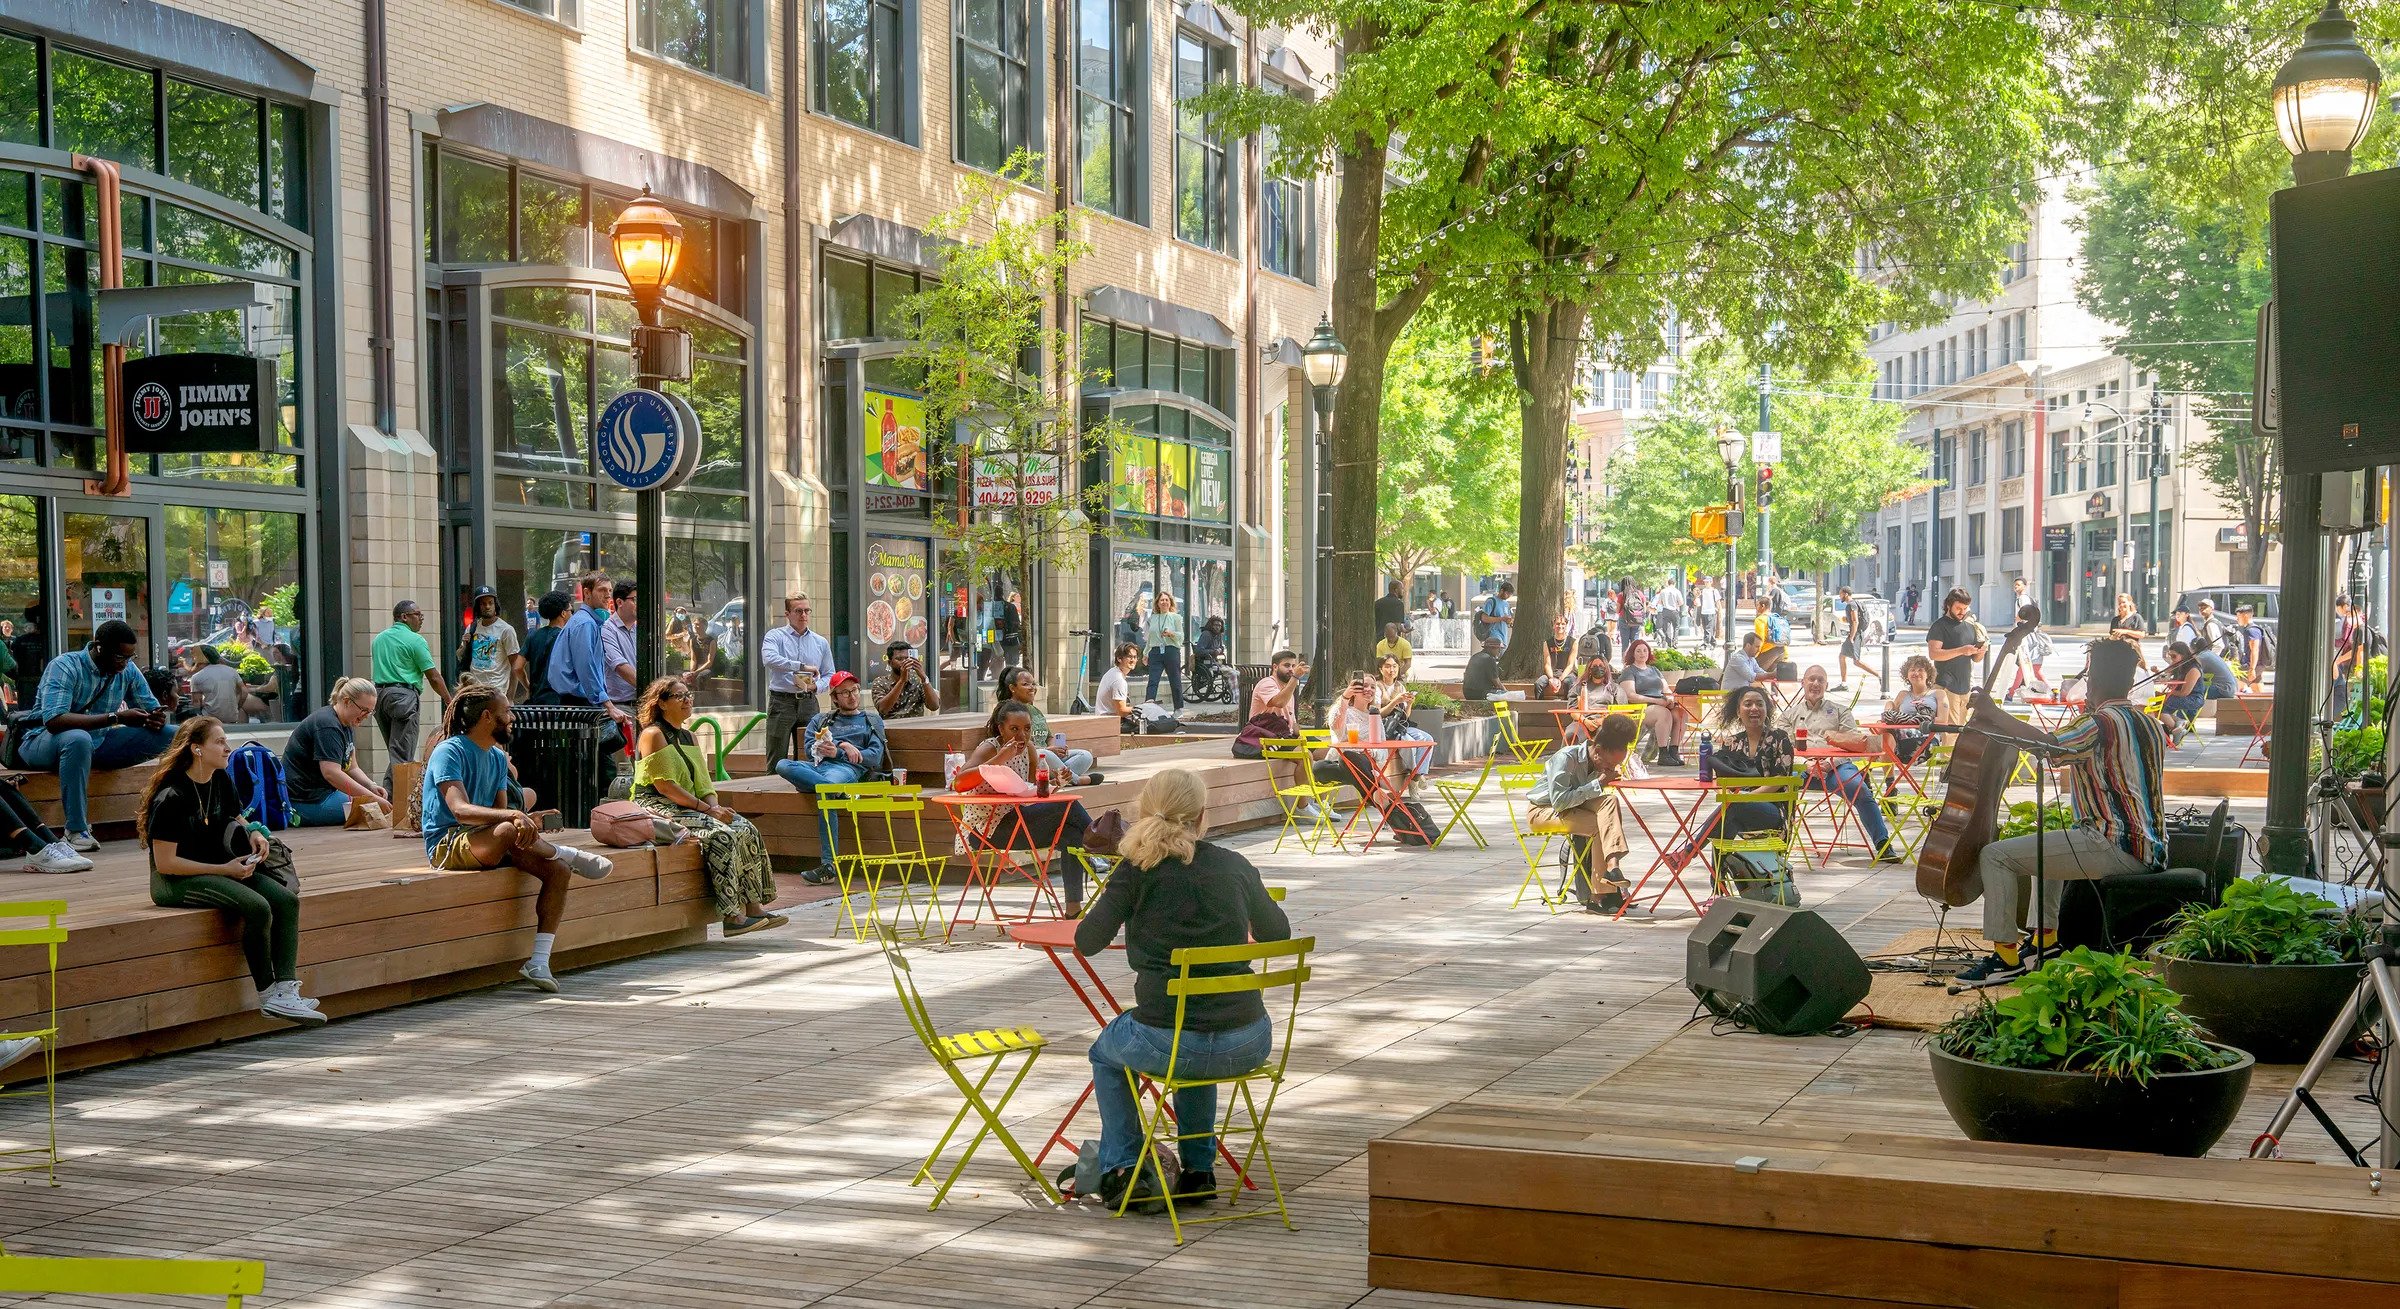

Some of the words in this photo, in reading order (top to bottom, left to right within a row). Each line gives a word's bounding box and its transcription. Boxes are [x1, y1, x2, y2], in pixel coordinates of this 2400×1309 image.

[144, 396, 161, 419] JJ
[179, 384, 251, 408] JIMMY
[180, 408, 252, 431] JOHN'S
[600, 418, 615, 471] GEORGIA
[612, 395, 643, 412] STATE
[649, 399, 674, 468] UNIVERSITY
[626, 476, 649, 484] 1913
[1200, 465, 1214, 479] LOVES
[1201, 478, 1221, 507] DEW
[877, 552, 906, 568] Mama
[907, 554, 925, 569] Mia
